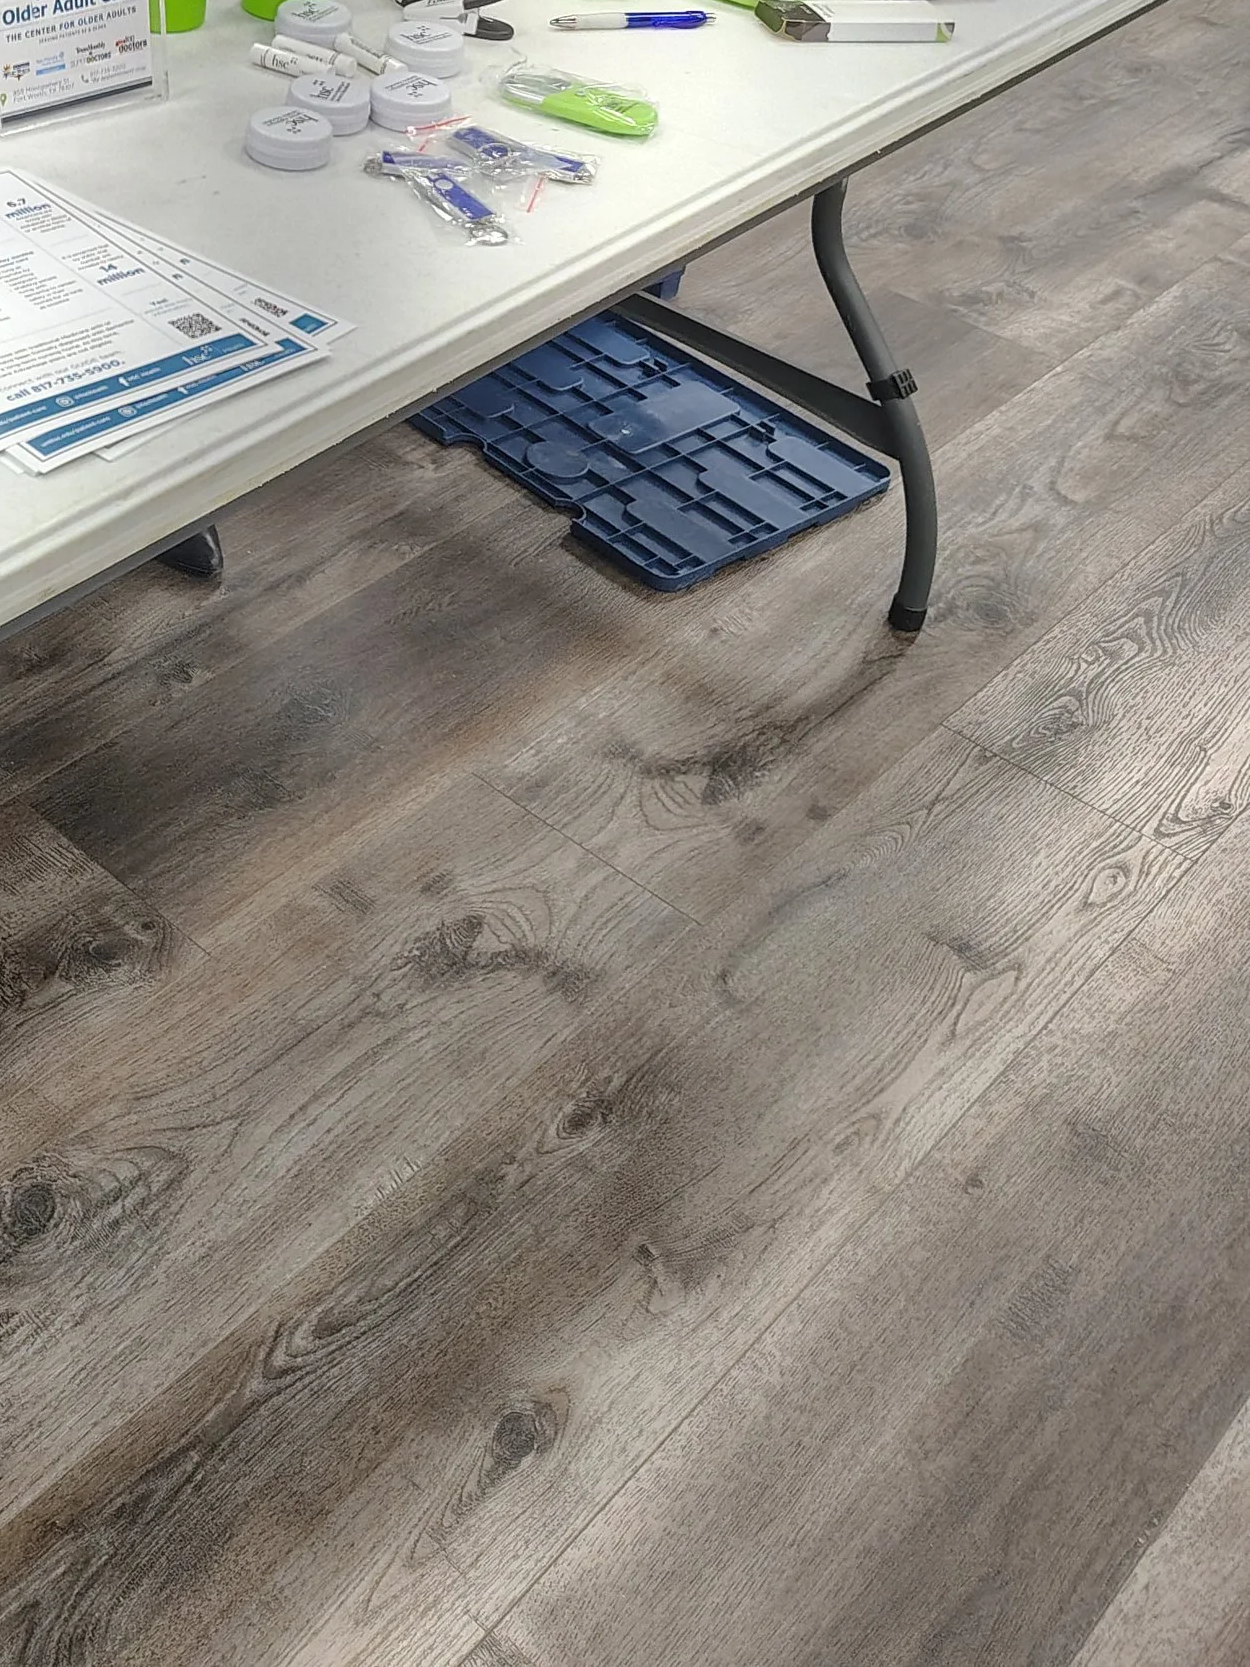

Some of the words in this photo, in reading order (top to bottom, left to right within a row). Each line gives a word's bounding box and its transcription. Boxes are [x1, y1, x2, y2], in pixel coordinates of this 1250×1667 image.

[2, 1, 47, 25] Older
[6, 32, 22, 43] THE
[25, 25, 57, 38] CENTER
[59, 20, 74, 30] FOR
[78, 12, 104, 26] OLDER
[106, 6, 136, 21] ADULTS
[271, 54, 290, 69] hsc
[5, 202, 51, 219] million
[6, 198, 27, 208] 6.7
[99, 264, 118, 272] 14
[97, 268, 145, 285] million
[6, 389, 31, 402] call
